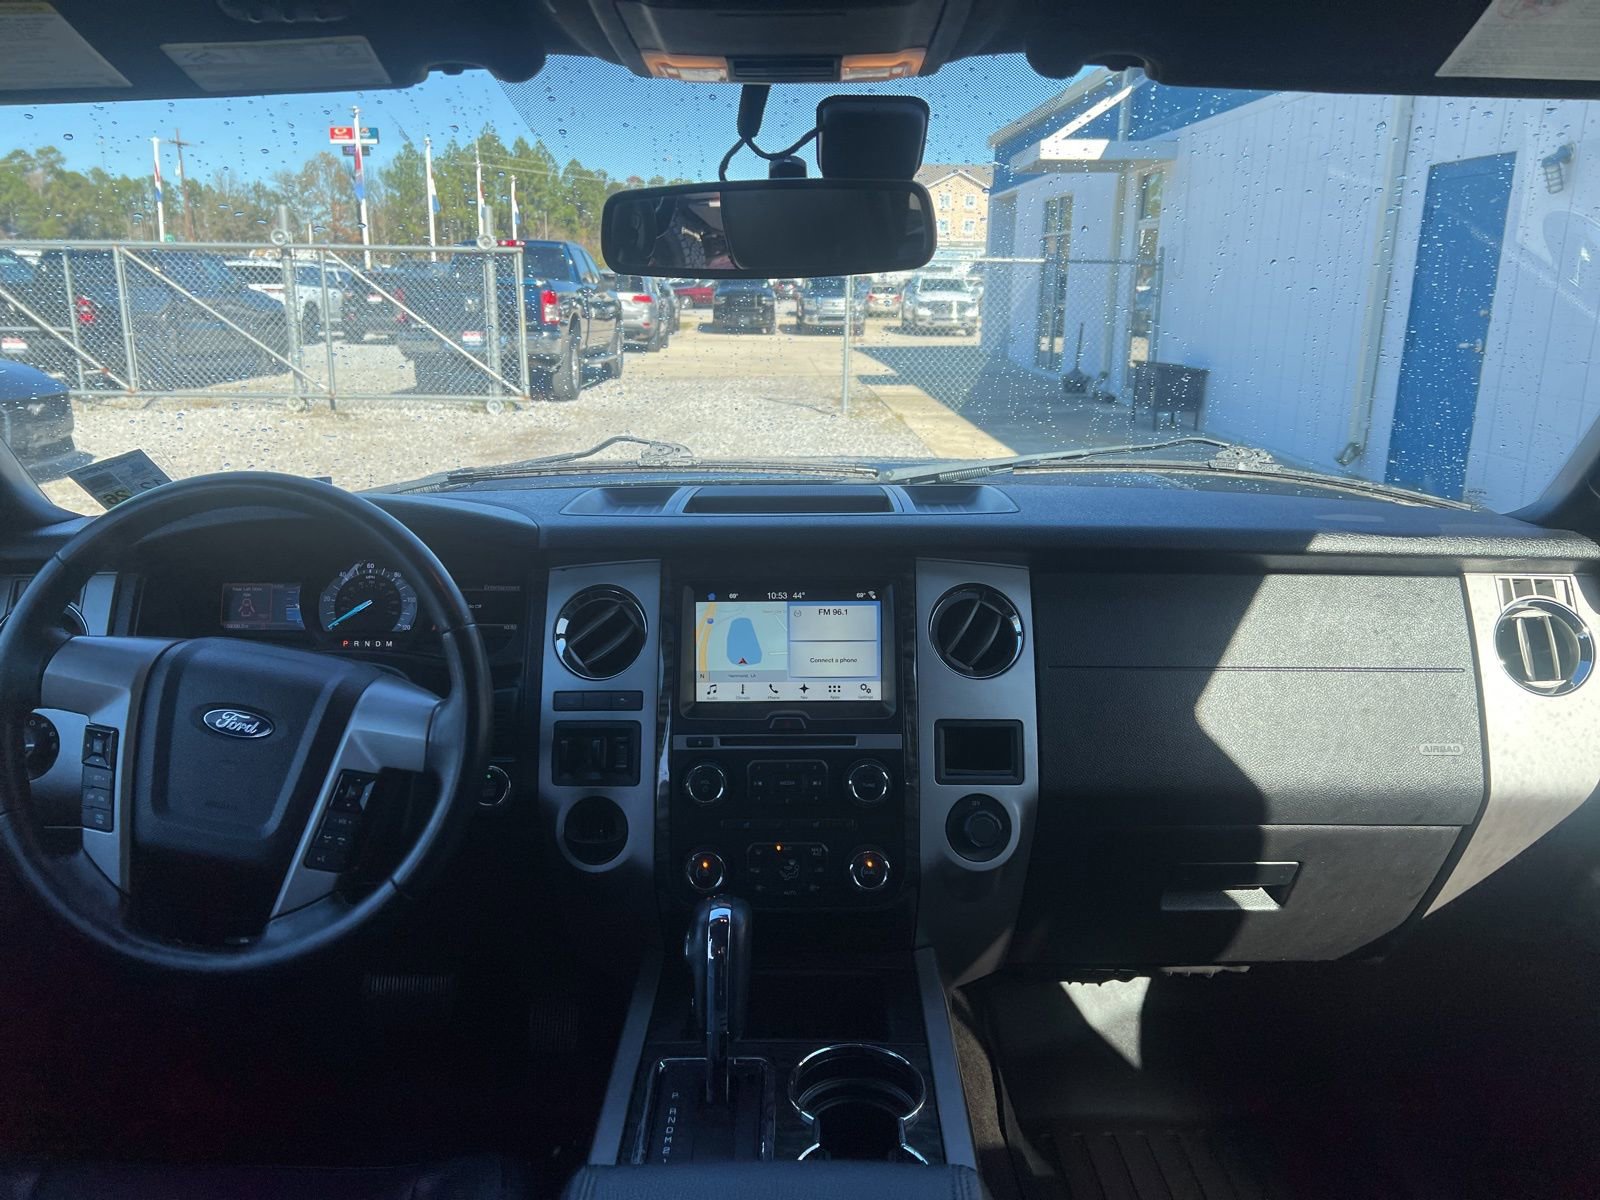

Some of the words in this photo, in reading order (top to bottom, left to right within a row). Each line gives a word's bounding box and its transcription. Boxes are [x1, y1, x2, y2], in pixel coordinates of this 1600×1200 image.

[767, 592, 788, 600] 10:53
[818, 608, 831, 616] FM
[832, 608, 848, 616] 96.1
[839, 657, 858, 665] phone
[215, 711, 260, 734] Ford
